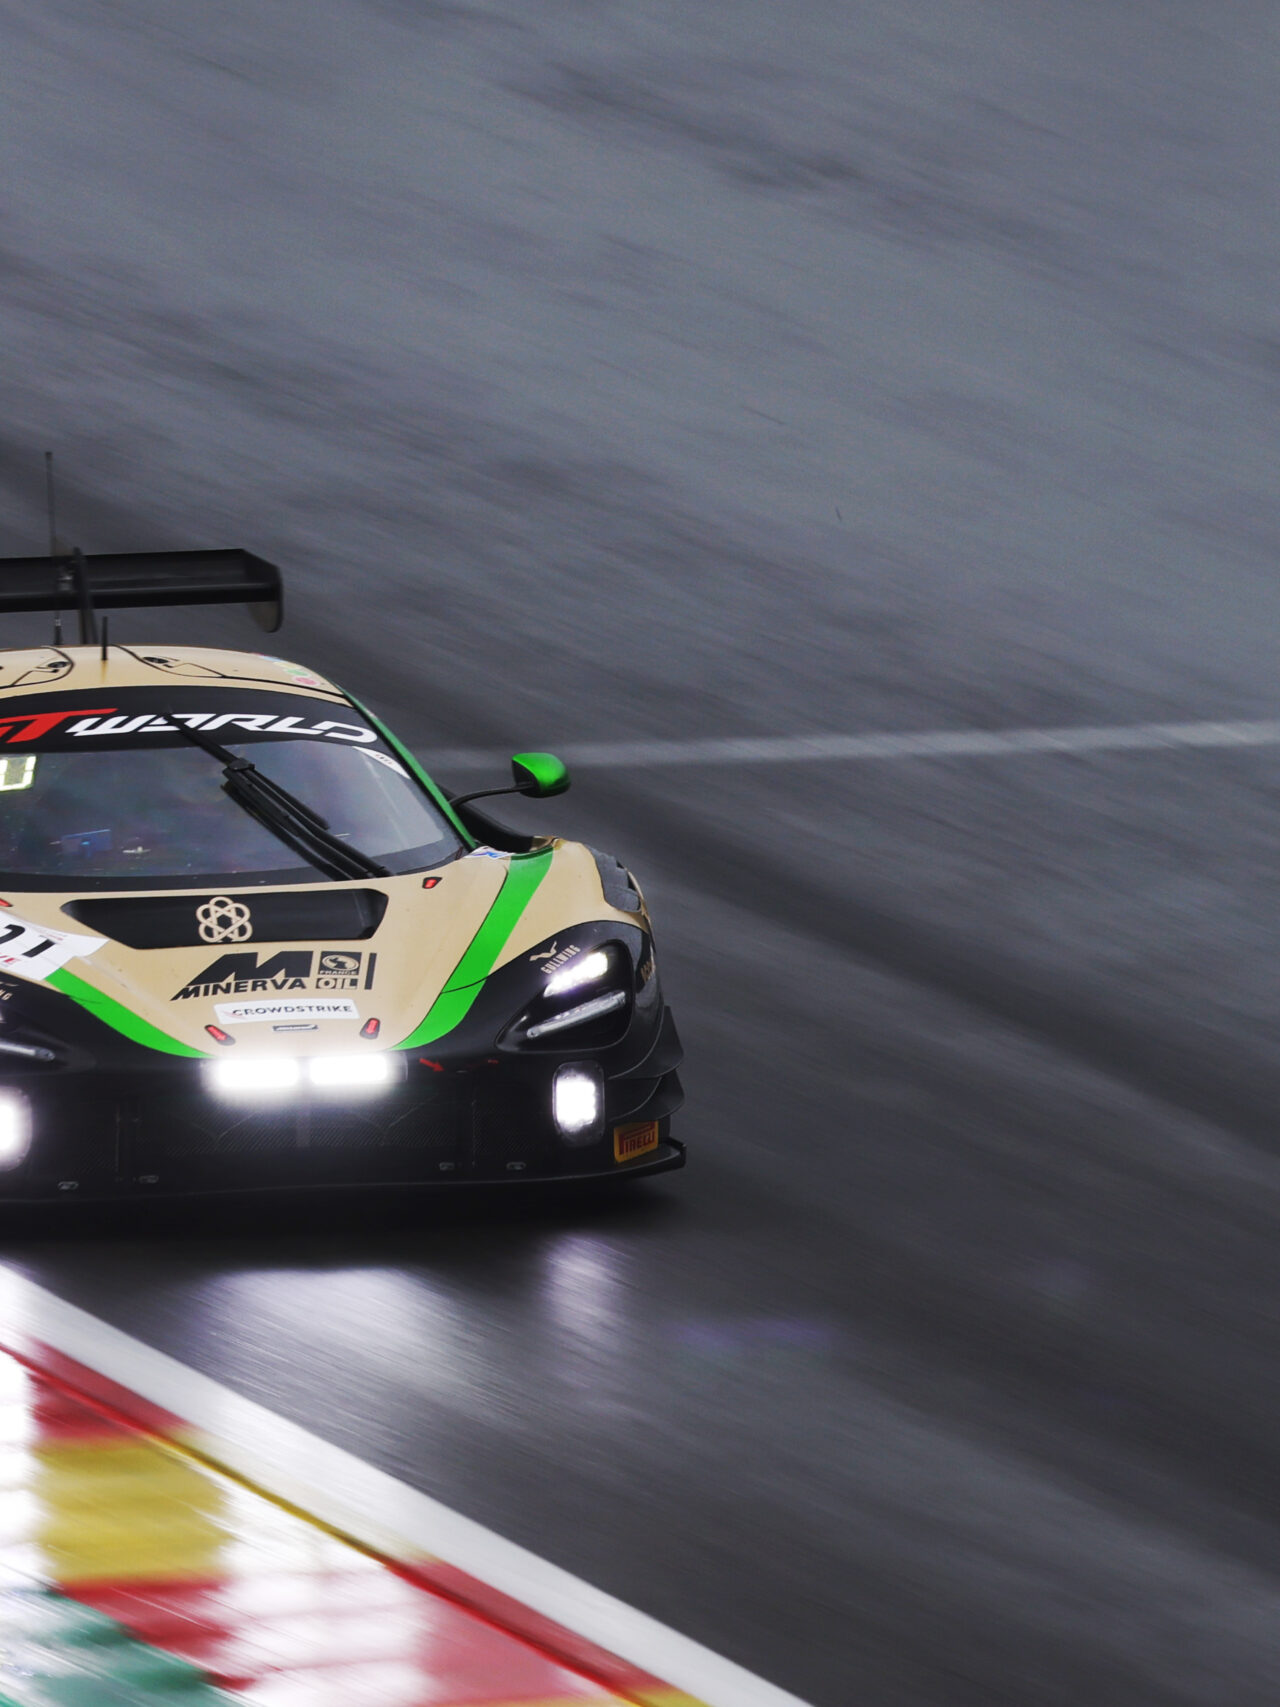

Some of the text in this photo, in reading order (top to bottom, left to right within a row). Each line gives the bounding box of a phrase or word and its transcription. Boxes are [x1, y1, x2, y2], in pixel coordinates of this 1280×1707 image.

[540, 944, 581, 974] GULLWING
[170, 977, 359, 1001] MINERVA OIL
[232, 1005, 353, 1017] CROWDSTRIKE
[618, 1120, 656, 1156] PIRELLI
